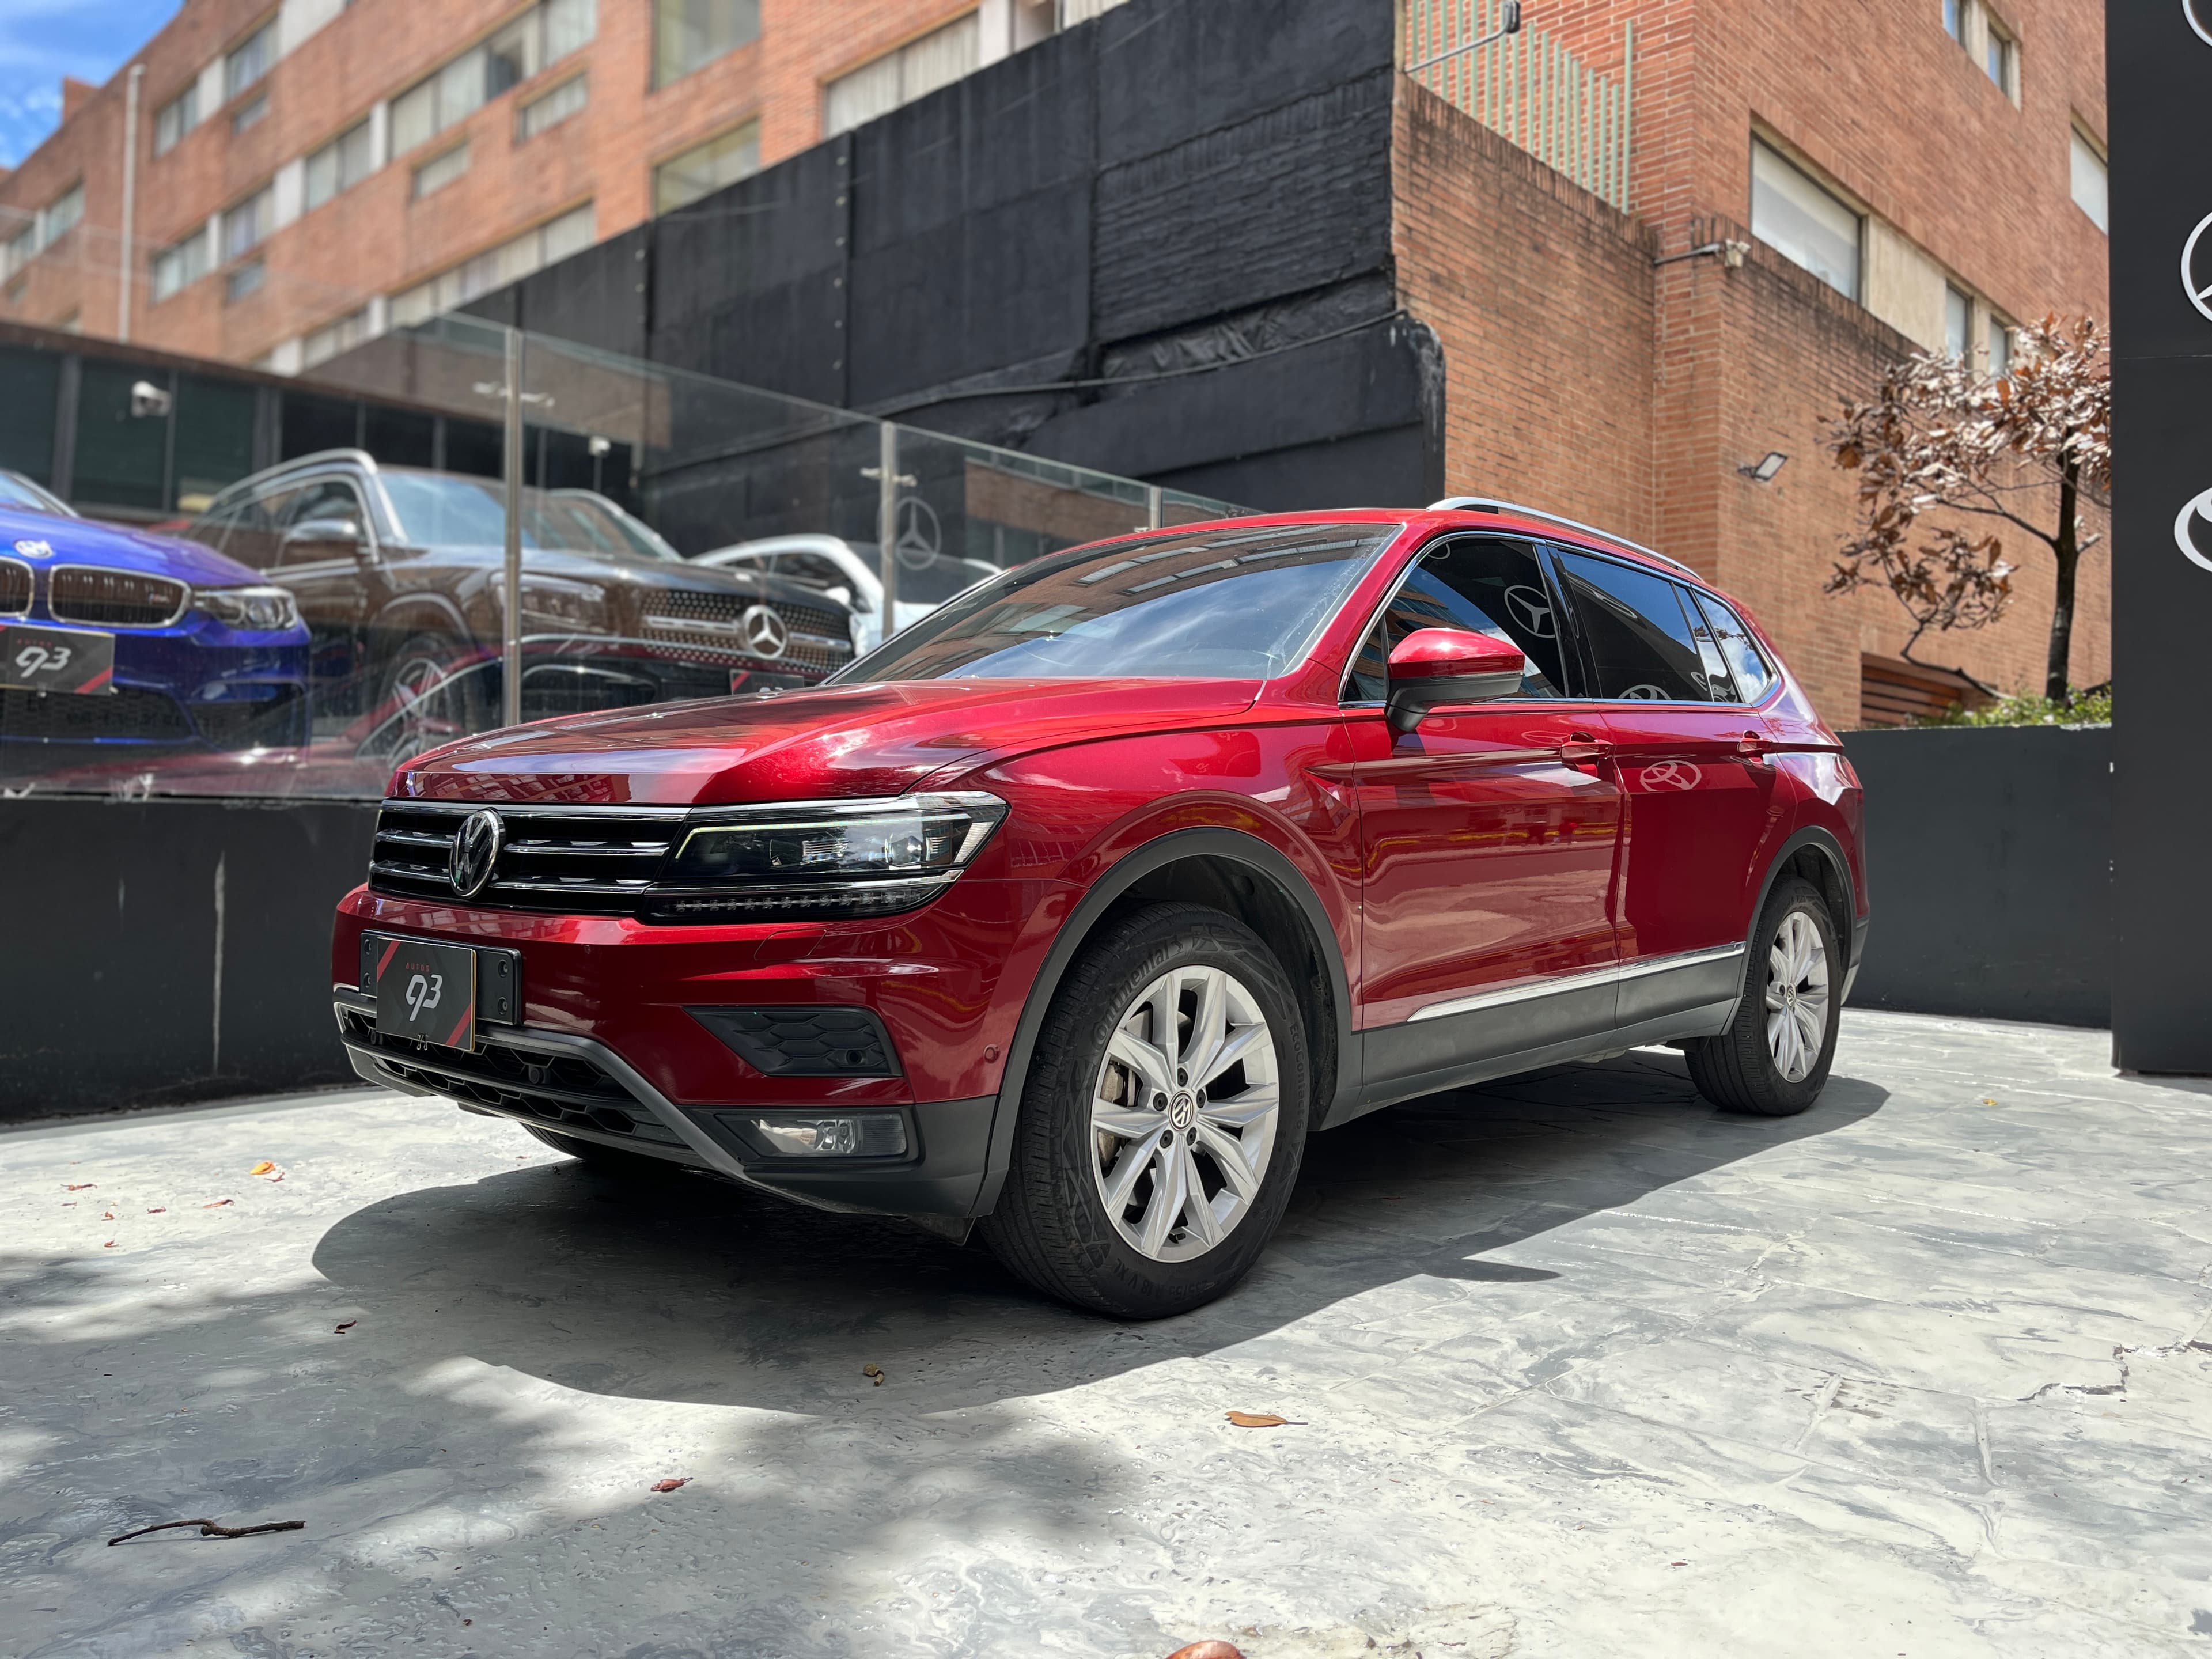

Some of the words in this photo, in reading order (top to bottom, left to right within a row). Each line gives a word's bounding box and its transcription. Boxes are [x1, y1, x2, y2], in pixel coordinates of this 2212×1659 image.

[15, 646, 72, 678] 93
[405, 963, 430, 972] AUTOS
[405, 974, 443, 1022] 93
[1093, 940, 1170, 1052] Continental
[1289, 1022, 1306, 1116] EcoContact
